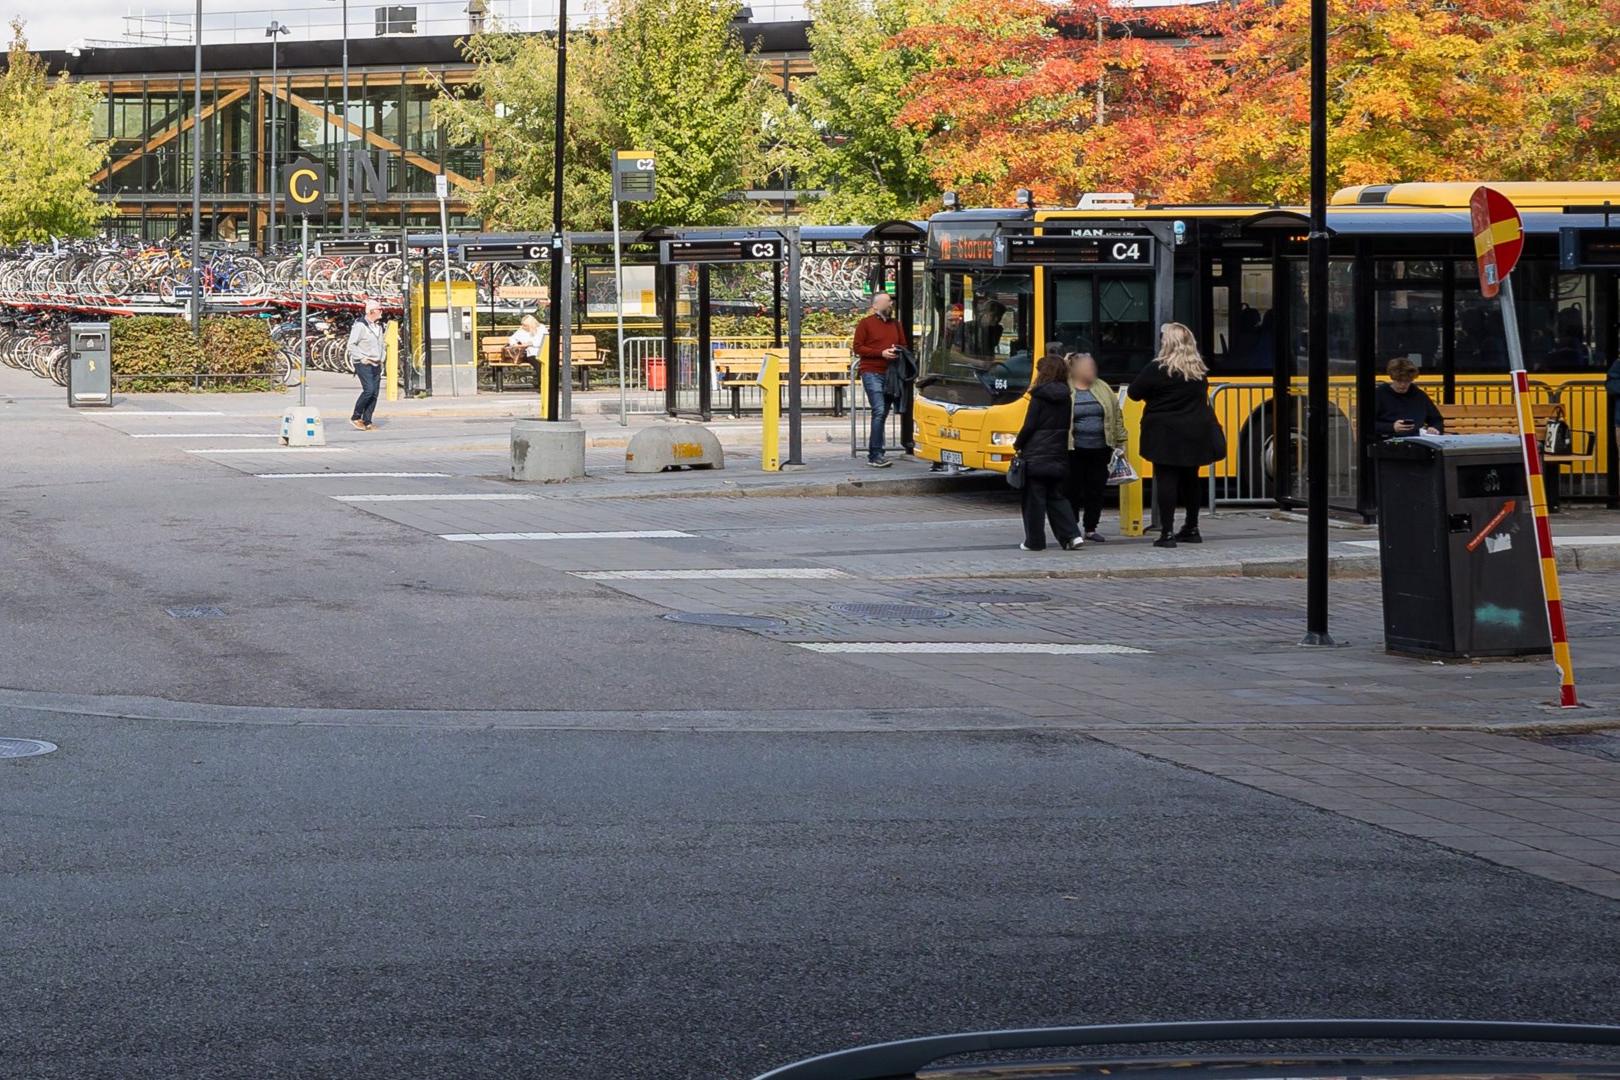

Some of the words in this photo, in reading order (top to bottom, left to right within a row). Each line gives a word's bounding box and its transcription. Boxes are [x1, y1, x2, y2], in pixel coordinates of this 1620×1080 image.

[636, 158, 655, 170] C2
[289, 169, 319, 204] C
[1071, 229, 1104, 237] MAN
[374, 243, 389, 254] C1
[529, 246, 549, 258] C2
[751, 243, 775, 258] C3
[1111, 242, 1140, 260] C4
[995, 379, 1007, 389] 664
